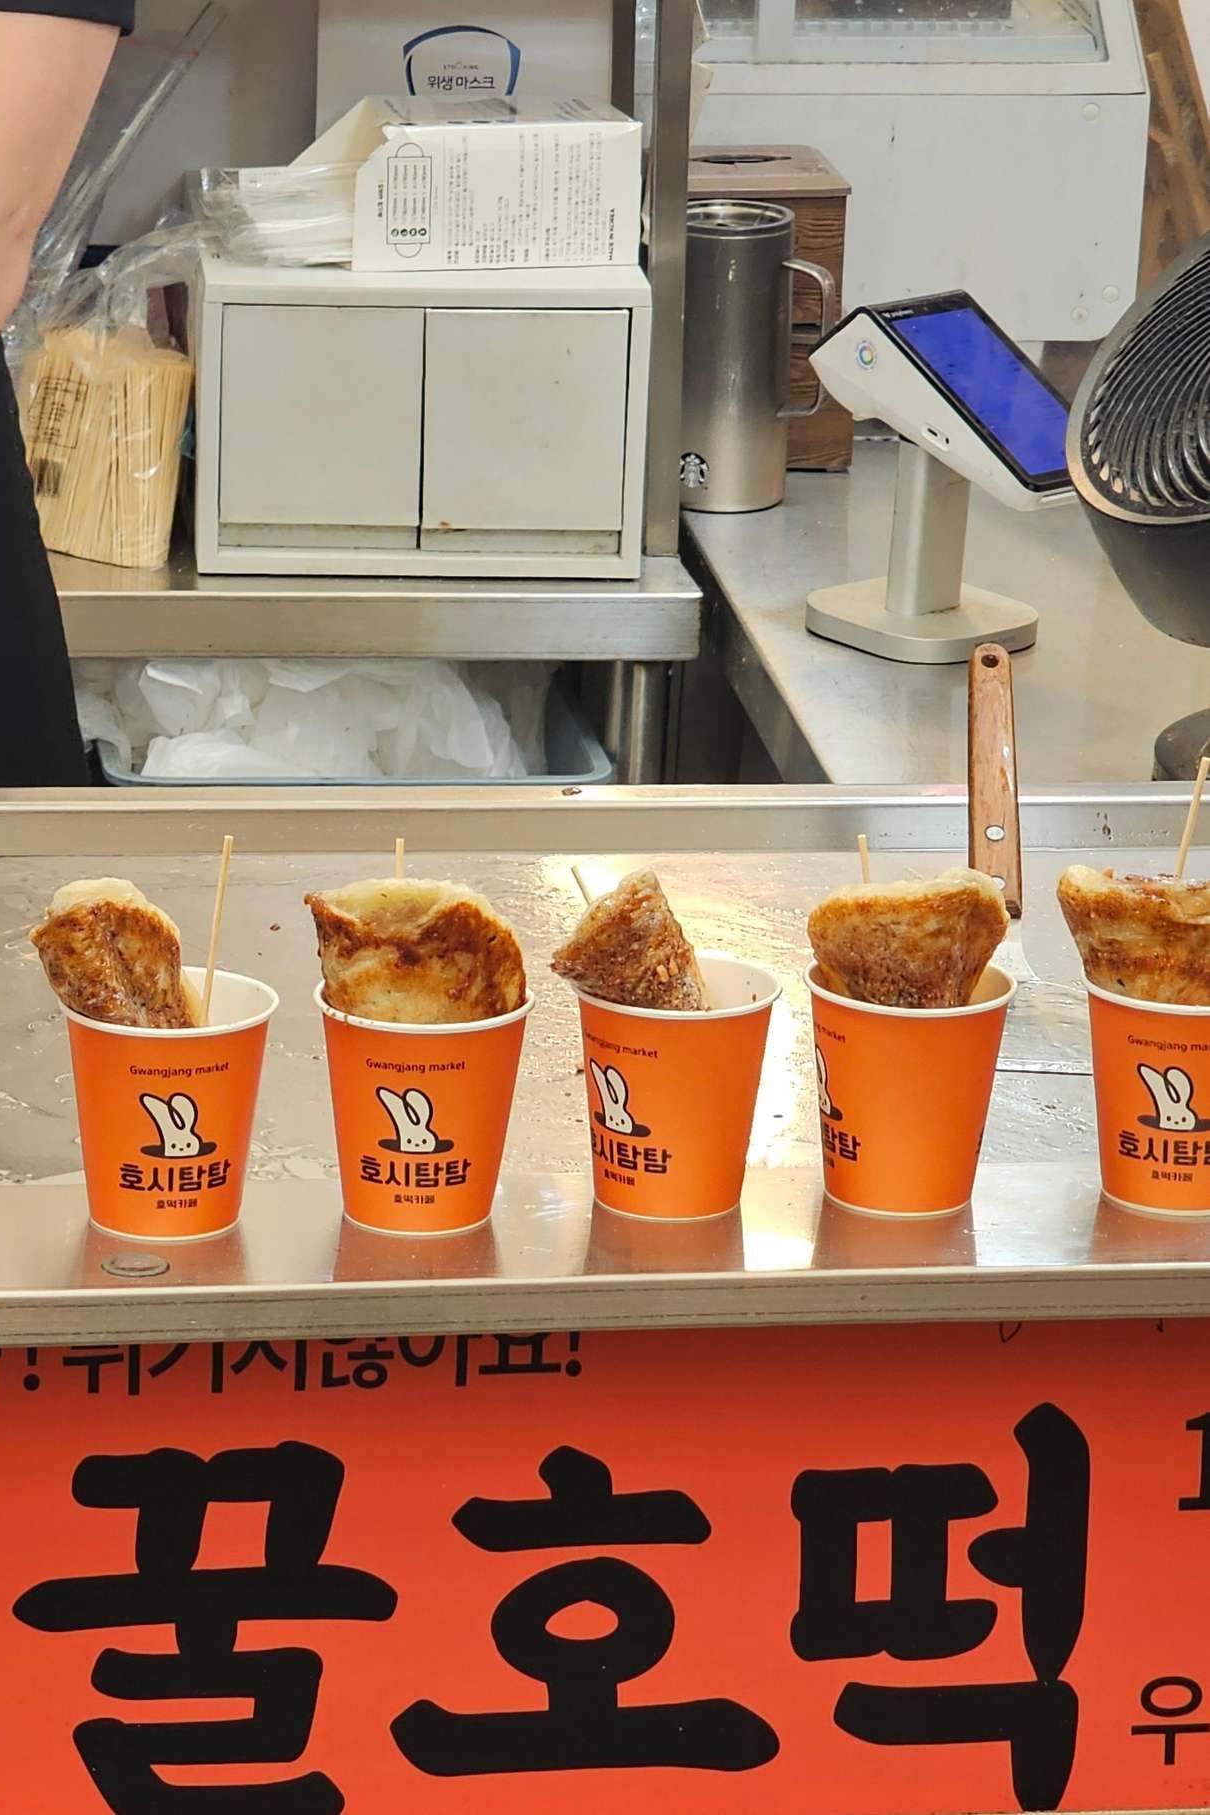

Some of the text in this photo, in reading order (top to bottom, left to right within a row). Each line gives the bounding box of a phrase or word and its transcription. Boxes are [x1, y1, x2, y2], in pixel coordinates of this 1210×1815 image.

[427, 75, 495, 91] 위생 마스크
[1127, 1034, 1188, 1053] Gwangjang
[621, 1045, 659, 1059] market
[129, 1062, 229, 1079] Gwangjang market
[365, 1058, 465, 1074] Gwangjang market
[118, 1159, 232, 1193] 호시탐탐
[359, 1154, 472, 1189] 호시탐탐
[156, 1198, 198, 1210] 호떡카페
[393, 1193, 436, 1205] 호떡카페
[12, 1402, 1091, 1815] 꿀호떡
